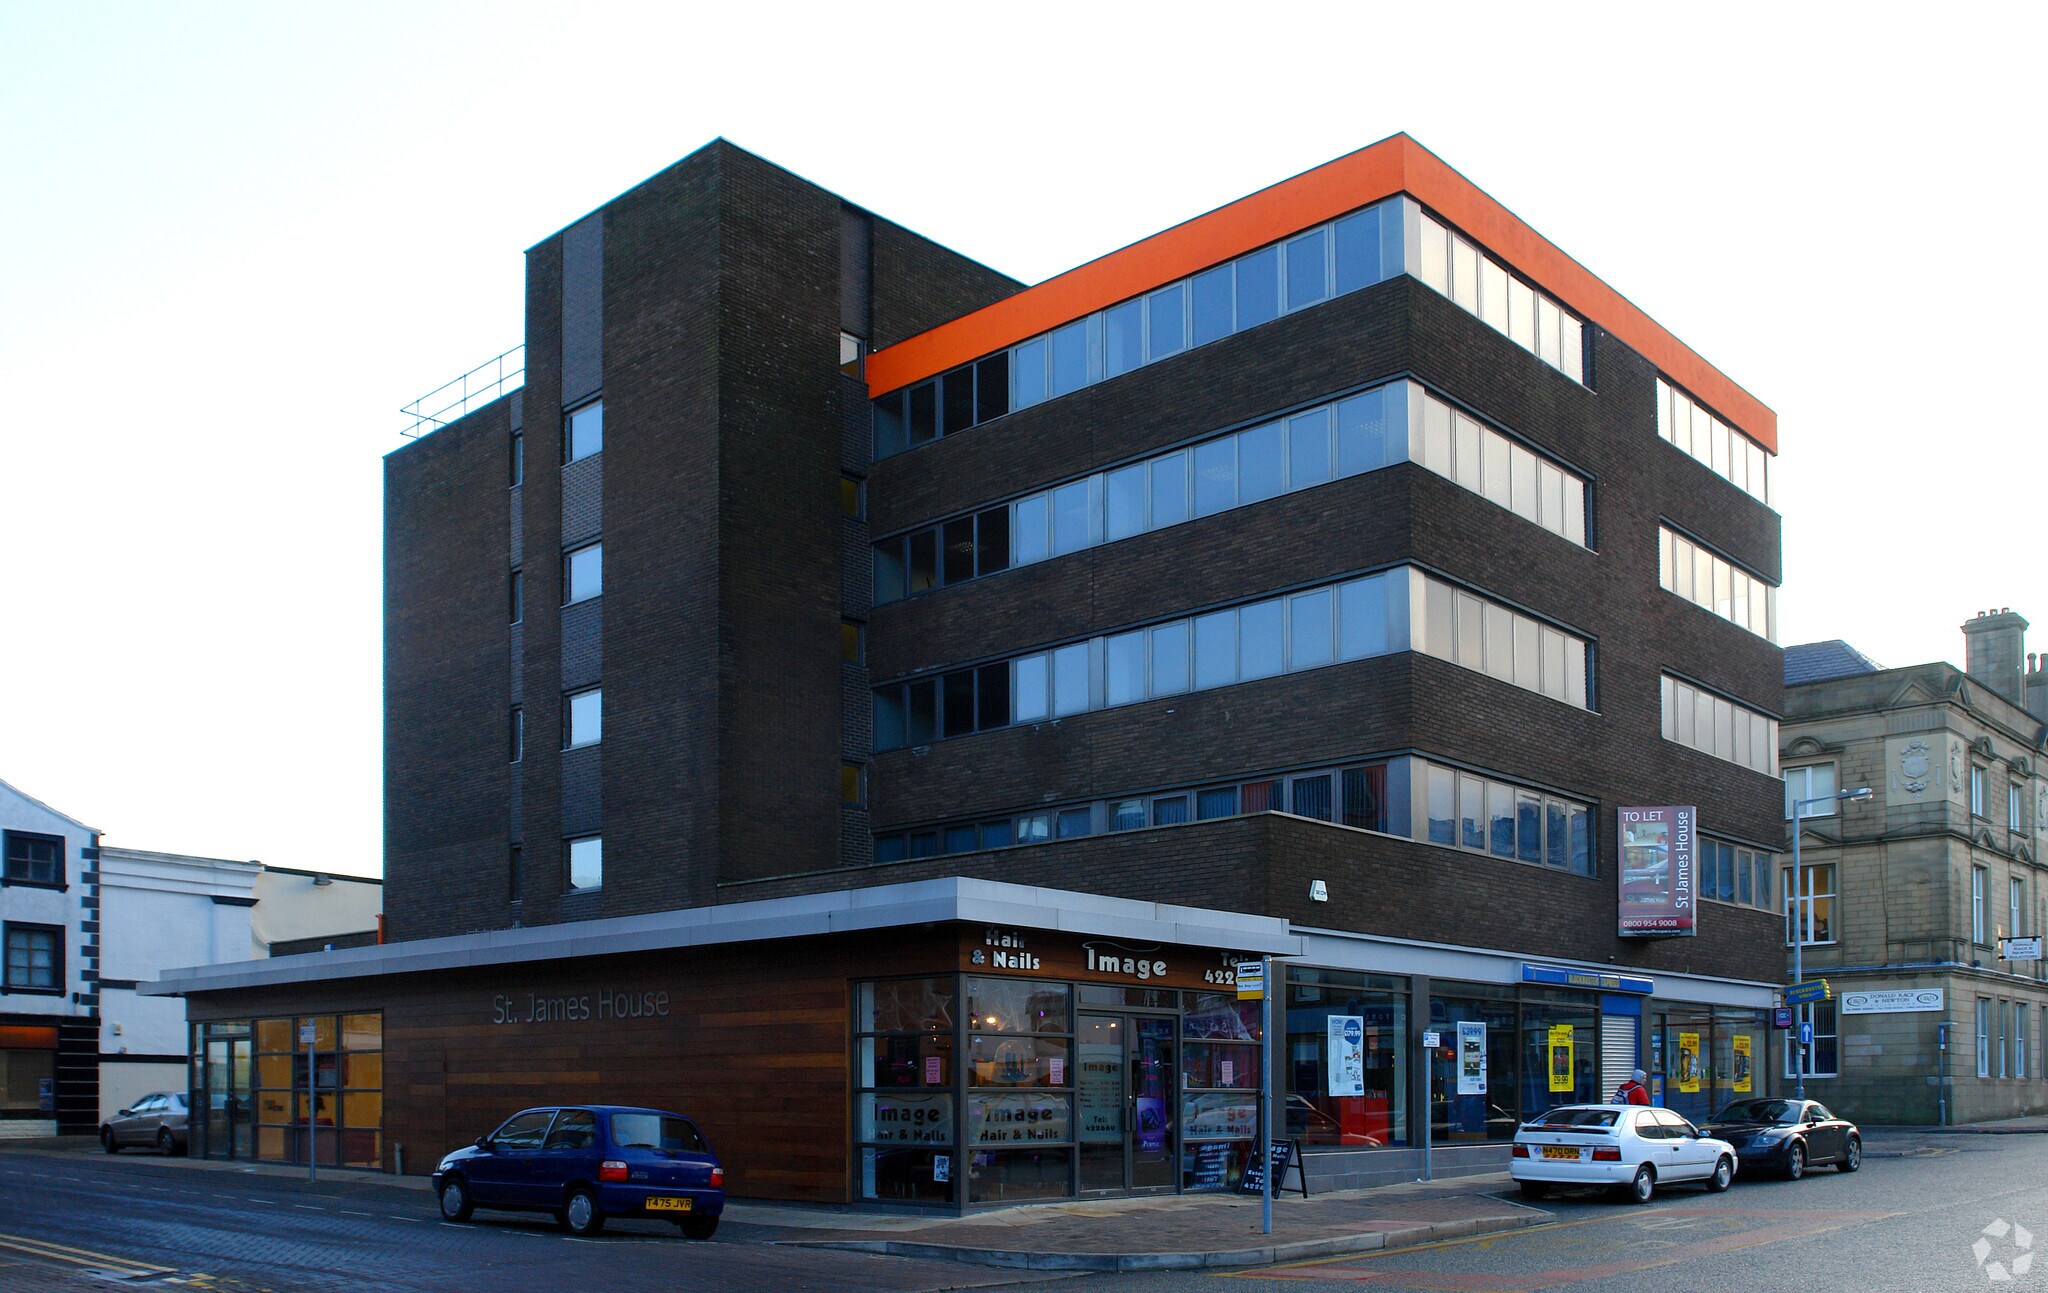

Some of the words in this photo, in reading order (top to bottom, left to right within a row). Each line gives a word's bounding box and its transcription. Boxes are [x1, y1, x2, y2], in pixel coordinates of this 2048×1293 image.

[1623, 812, 1640, 821] TO
[1642, 811, 1663, 821] LET
[1676, 811, 1689, 851] House
[1676, 854, 1689, 893] James
[1676, 895, 1688, 909] St
[972, 949, 986, 964] &
[993, 950, 1040, 970] Nails
[1086, 948, 1167, 980] Image
[493, 994, 519, 1024] St.
[526, 993, 590, 1023] James
[600, 989, 670, 1019] House
[914, 1129, 946, 1142] Nails
[980, 1128, 1008, 1140] Hair
[1027, 1128, 1059, 1140] Nails
[1542, 1146, 1563, 1155] N470
[1564, 1146, 1580, 1155] DRN
[647, 1198, 671, 1208] T475
[673, 1199, 692, 1208] JVR
